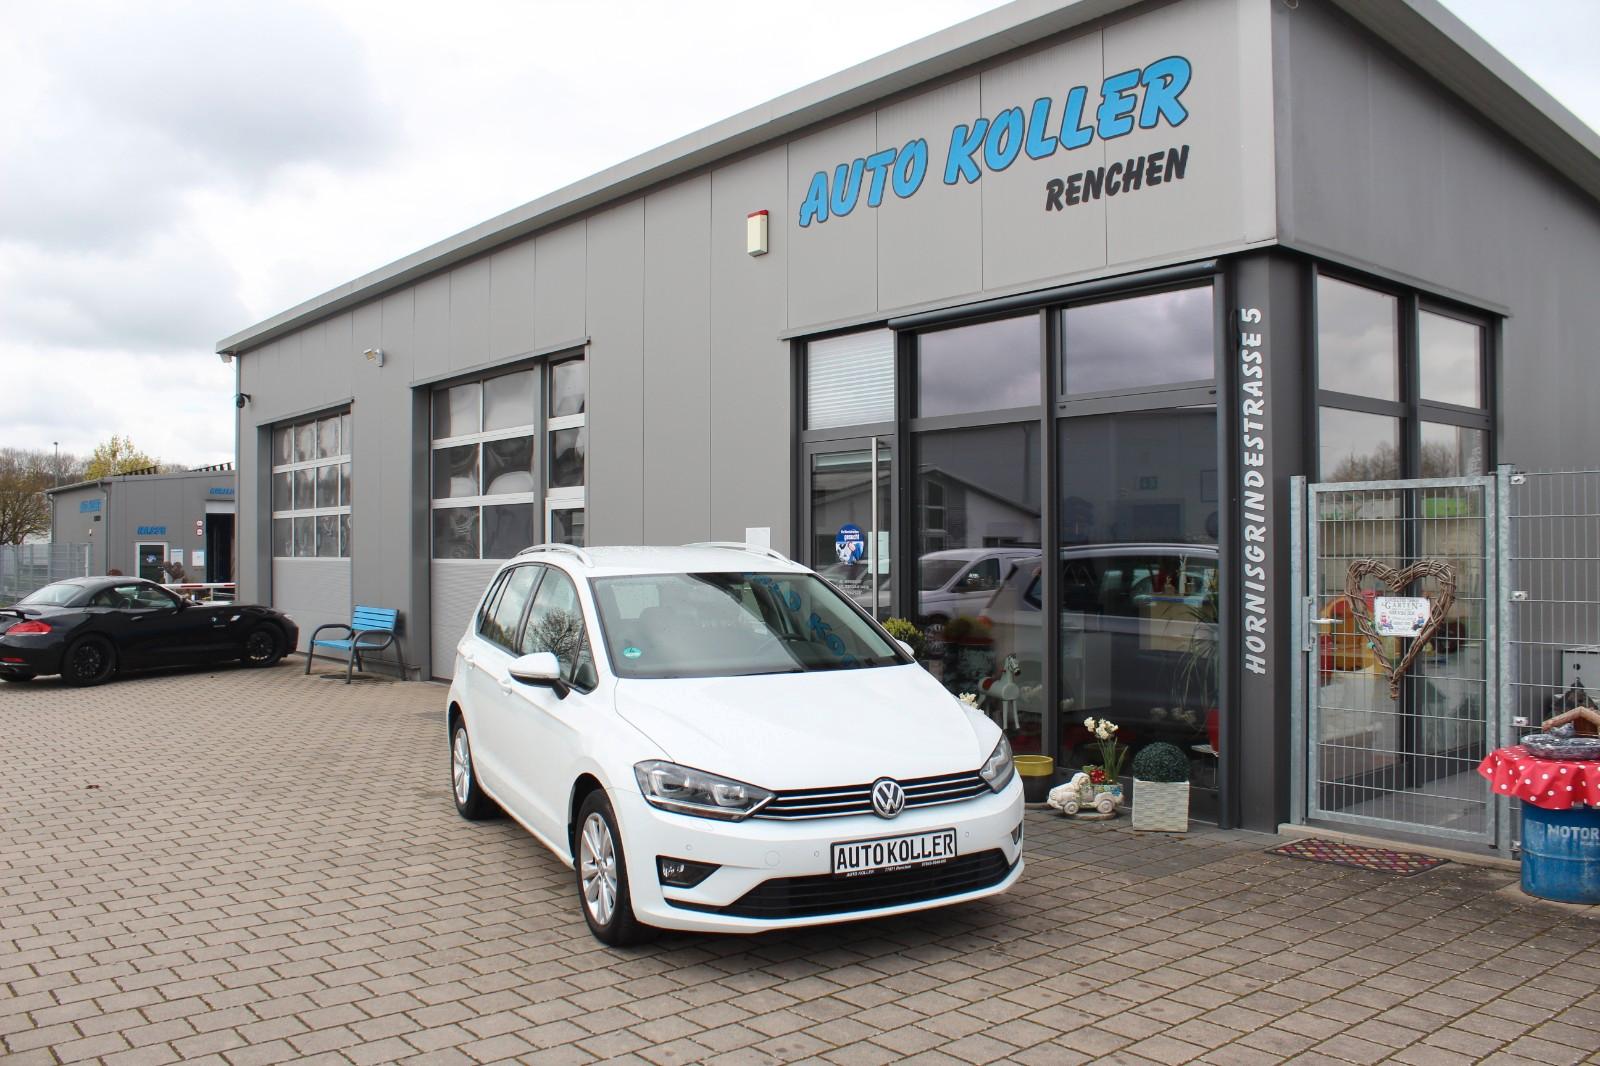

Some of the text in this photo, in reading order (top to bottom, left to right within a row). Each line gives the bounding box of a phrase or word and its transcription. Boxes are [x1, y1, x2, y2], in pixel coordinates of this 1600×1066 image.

[799, 55, 1192, 228] AUTO KOLLER
[1045, 144, 1191, 212] RENCHEN
[1241, 308, 1267, 675] HORNISGRINDESTRASSE 5
